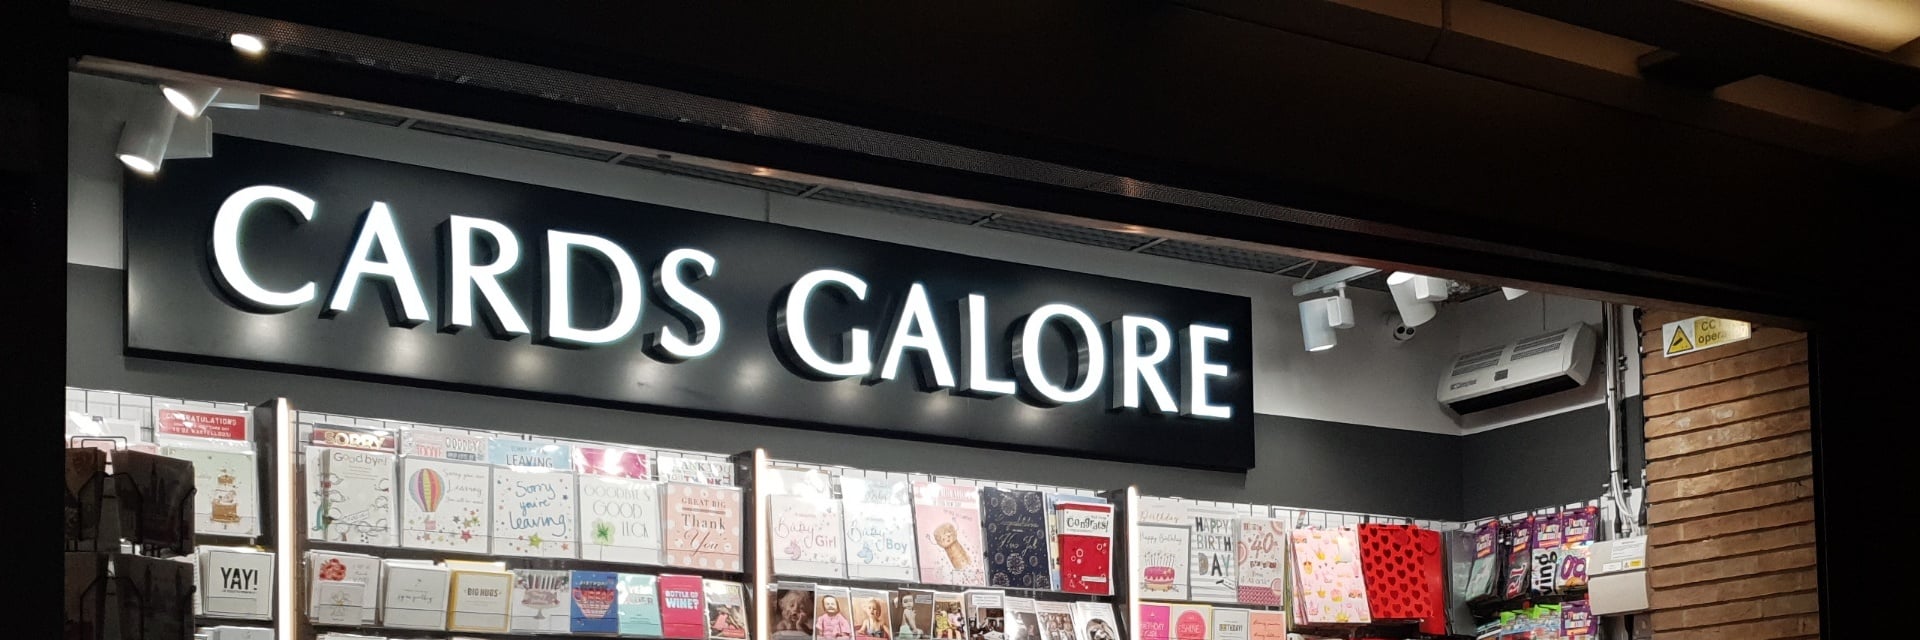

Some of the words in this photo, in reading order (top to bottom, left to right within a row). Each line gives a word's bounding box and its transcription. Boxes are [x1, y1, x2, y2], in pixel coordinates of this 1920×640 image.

[213, 185, 721, 357] CARDS
[786, 269, 1231, 419] GALORE
[165, 412, 237, 426] CORATULATIONS
[324, 430, 386, 449] SORRY
[505, 453, 553, 468] LEAVING
[515, 480, 556, 500] Sorry
[592, 500, 643, 519] GOOD
[681, 497, 709, 507] GREAT
[508, 511, 566, 537] leaving
[680, 513, 726, 530] Thank
[1066, 517, 1109, 533] Congrats!
[1195, 517, 1230, 534] HAPPY
[683, 529, 719, 557] You
[815, 536, 837, 549] Girl
[886, 538, 908, 554] Boy
[1196, 535, 1232, 551] BIRTH
[1250, 532, 1274, 559] 40
[1198, 552, 1231, 577] DAY
[220, 566, 259, 591] YAY!
[467, 587, 479, 597] BIG
[480, 588, 498, 598] HUGS
[665, 590, 688, 598] BOTTLE
[665, 598, 699, 610] WINE?
